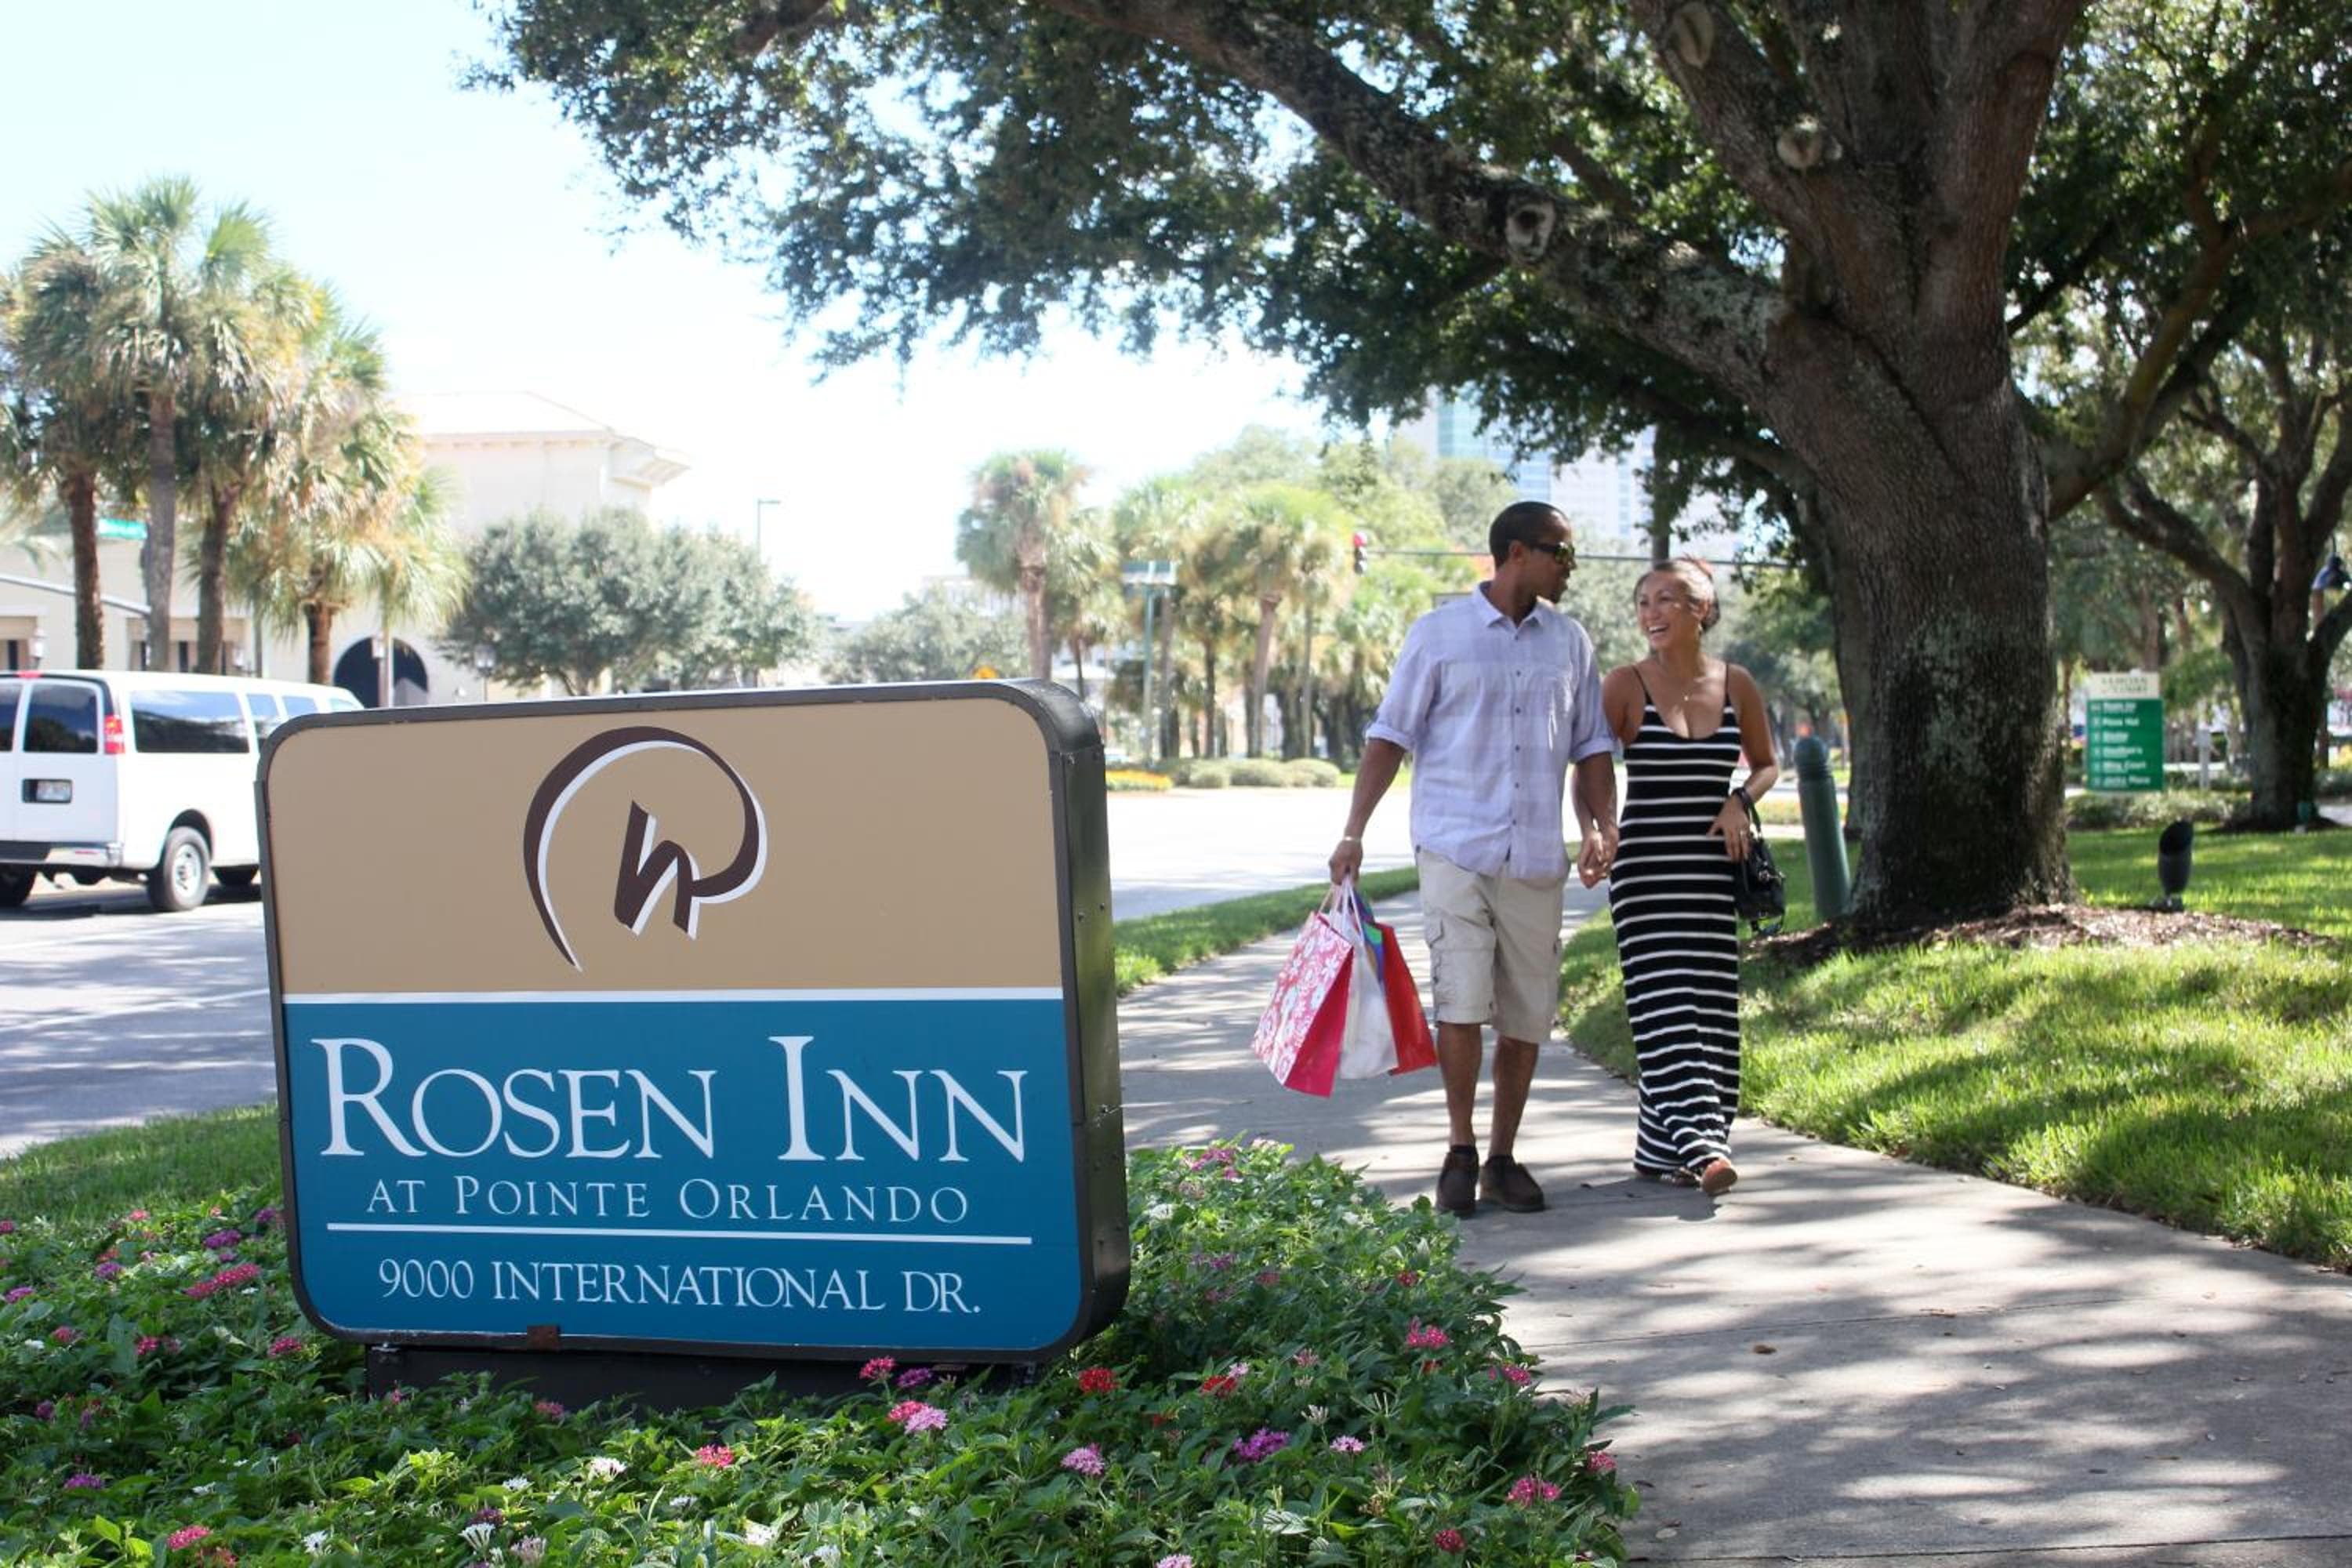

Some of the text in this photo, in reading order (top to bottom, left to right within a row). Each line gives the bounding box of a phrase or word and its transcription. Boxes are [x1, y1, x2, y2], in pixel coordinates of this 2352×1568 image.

[311, 1035, 1028, 1163] ROSEN INN
[367, 1175, 967, 1223] AT POINTE ORLANDO
[379, 1259, 981, 1314] 9000 INTERNATIONAL DR.
